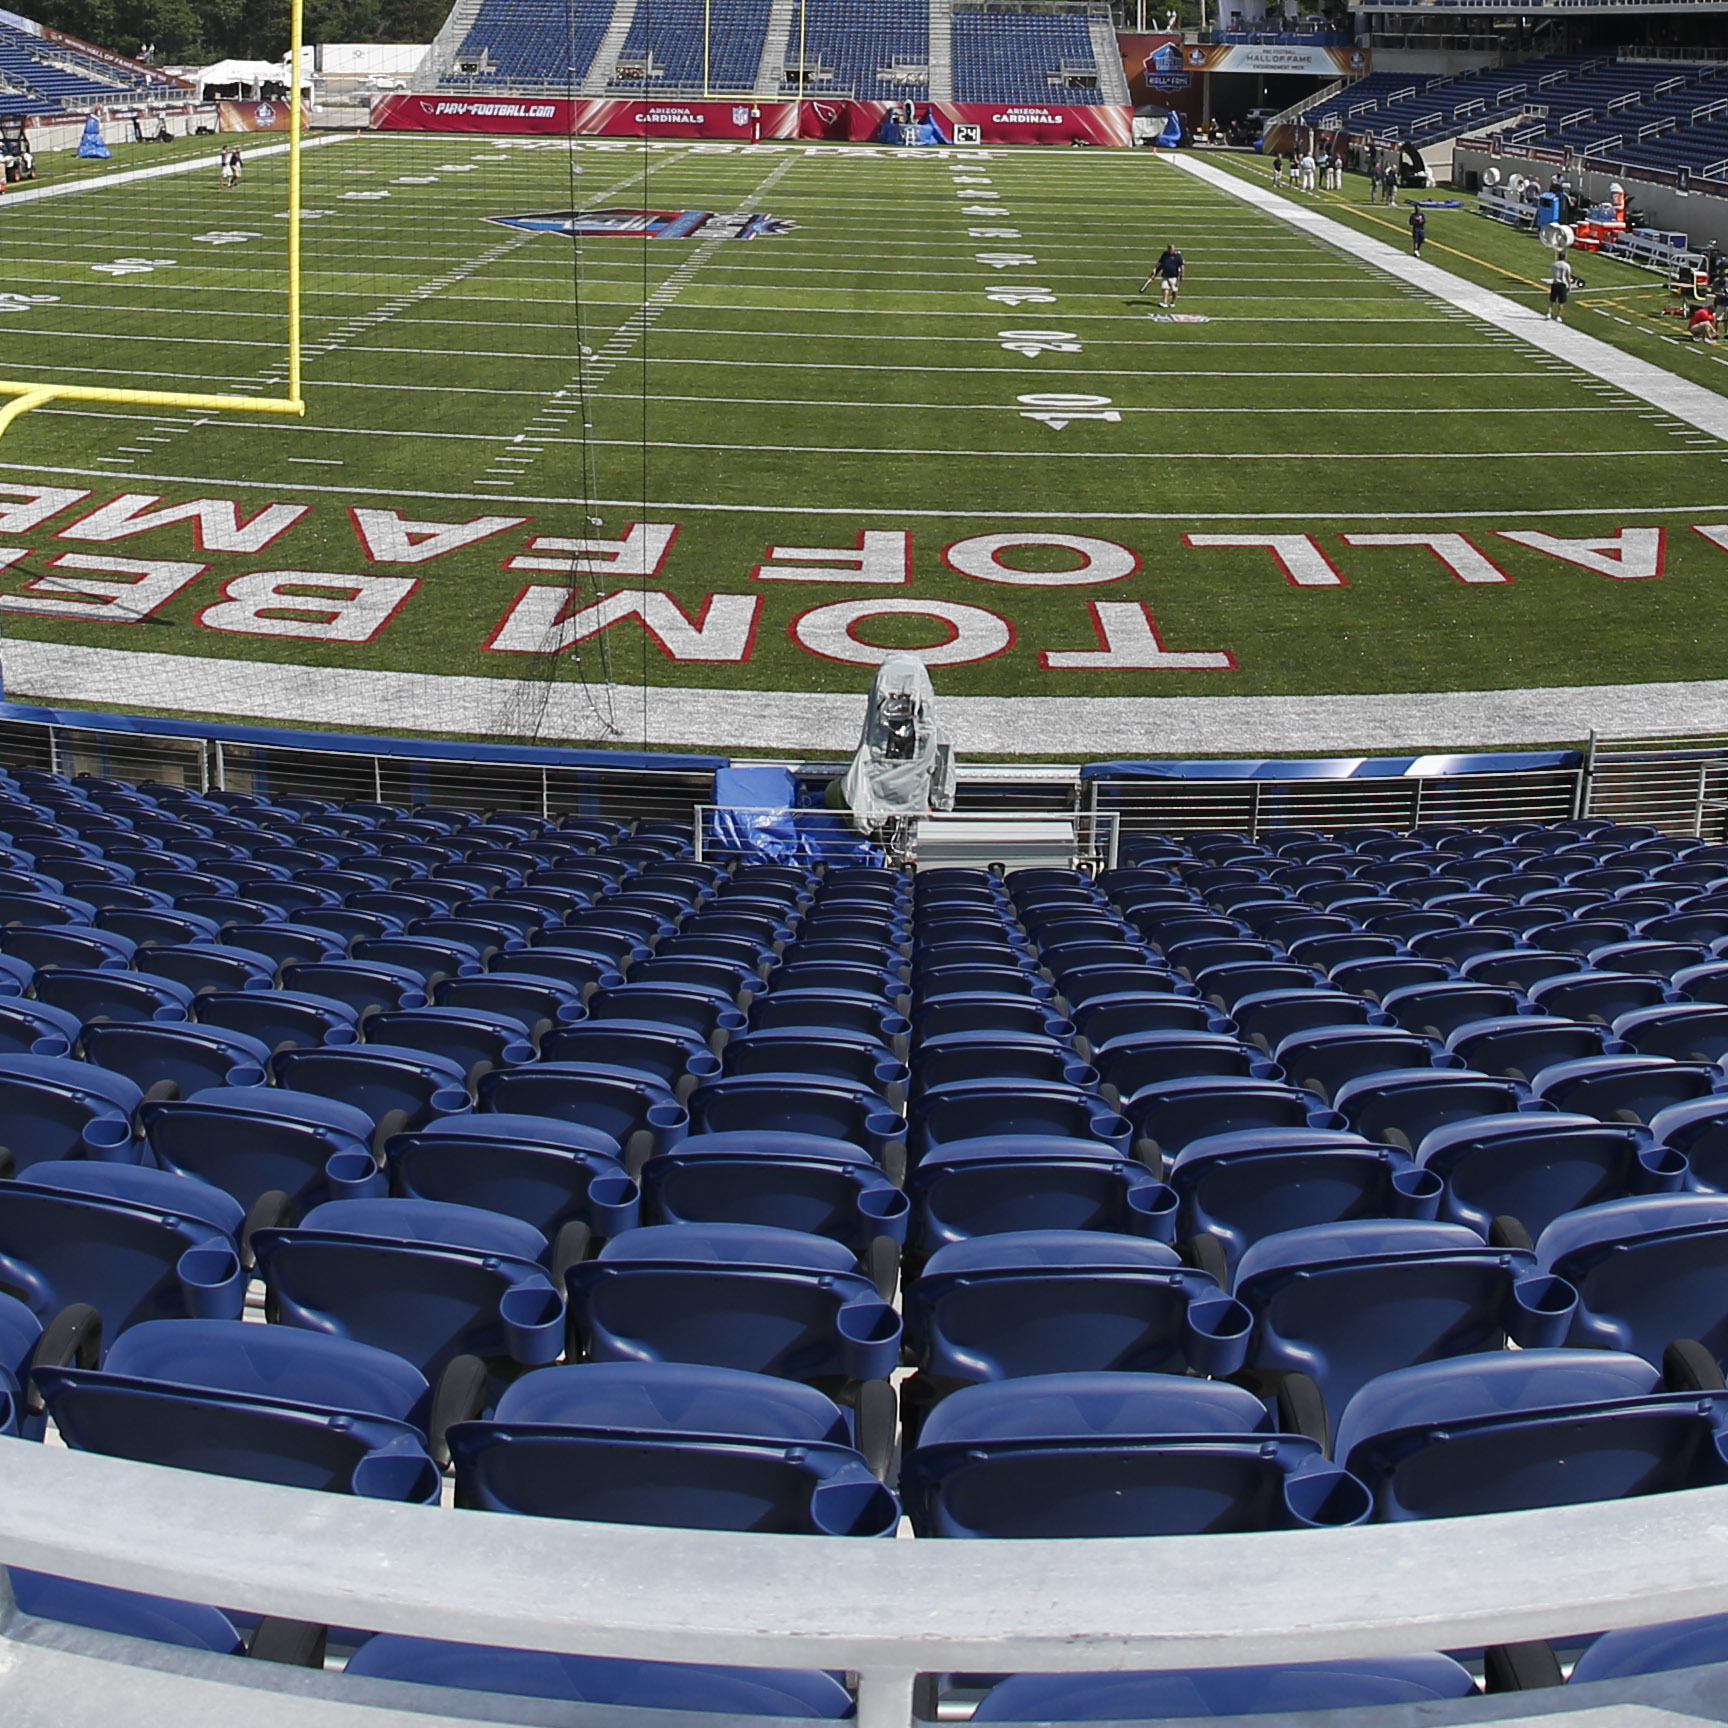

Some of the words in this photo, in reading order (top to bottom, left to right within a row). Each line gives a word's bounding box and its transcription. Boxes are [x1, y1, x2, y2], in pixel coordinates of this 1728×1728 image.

[1287, 55, 1312, 63] FAME
[649, 107, 690, 115] ARIZONA
[635, 114, 704, 124] CARDINALS
[992, 114, 1063, 124] CARDINALS
[958, 127, 976, 141] 24
[997, 330, 1083, 353] 20
[1016, 393, 1122, 422] 10
[750, 528, 1143, 588] OF
[482, 584, 1242, 671] TOM
